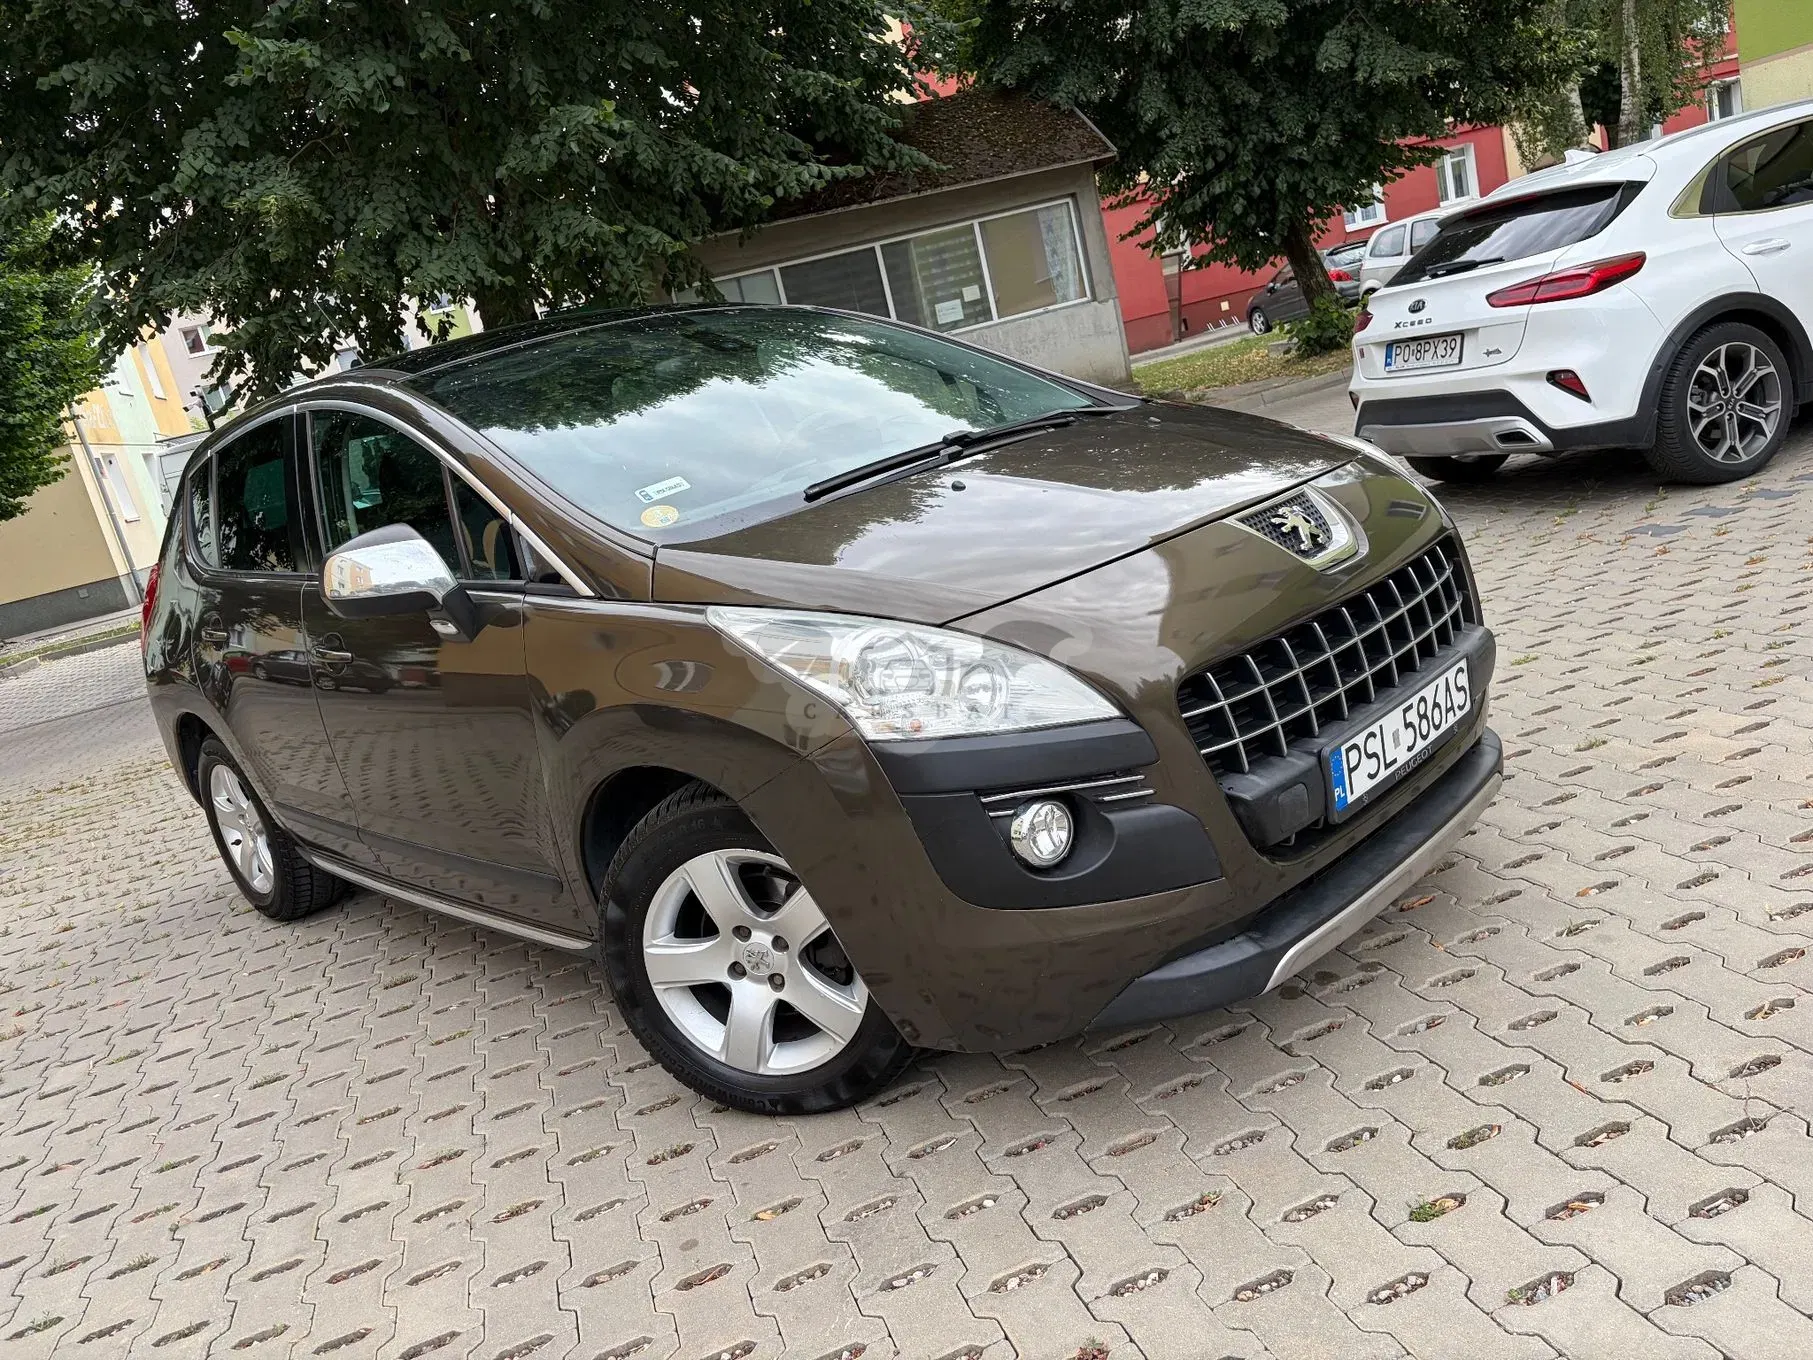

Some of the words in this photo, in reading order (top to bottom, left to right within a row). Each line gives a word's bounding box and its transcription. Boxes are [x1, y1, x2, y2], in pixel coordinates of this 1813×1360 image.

[1410, 300, 1424, 311] KIA
[1414, 337, 1458, 361] 8PX39
[1344, 723, 1398, 796] PSL
[1402, 666, 1468, 752] 586AS
[1395, 745, 1433, 780] PEUGEOT
[1334, 786, 1346, 802] PL
